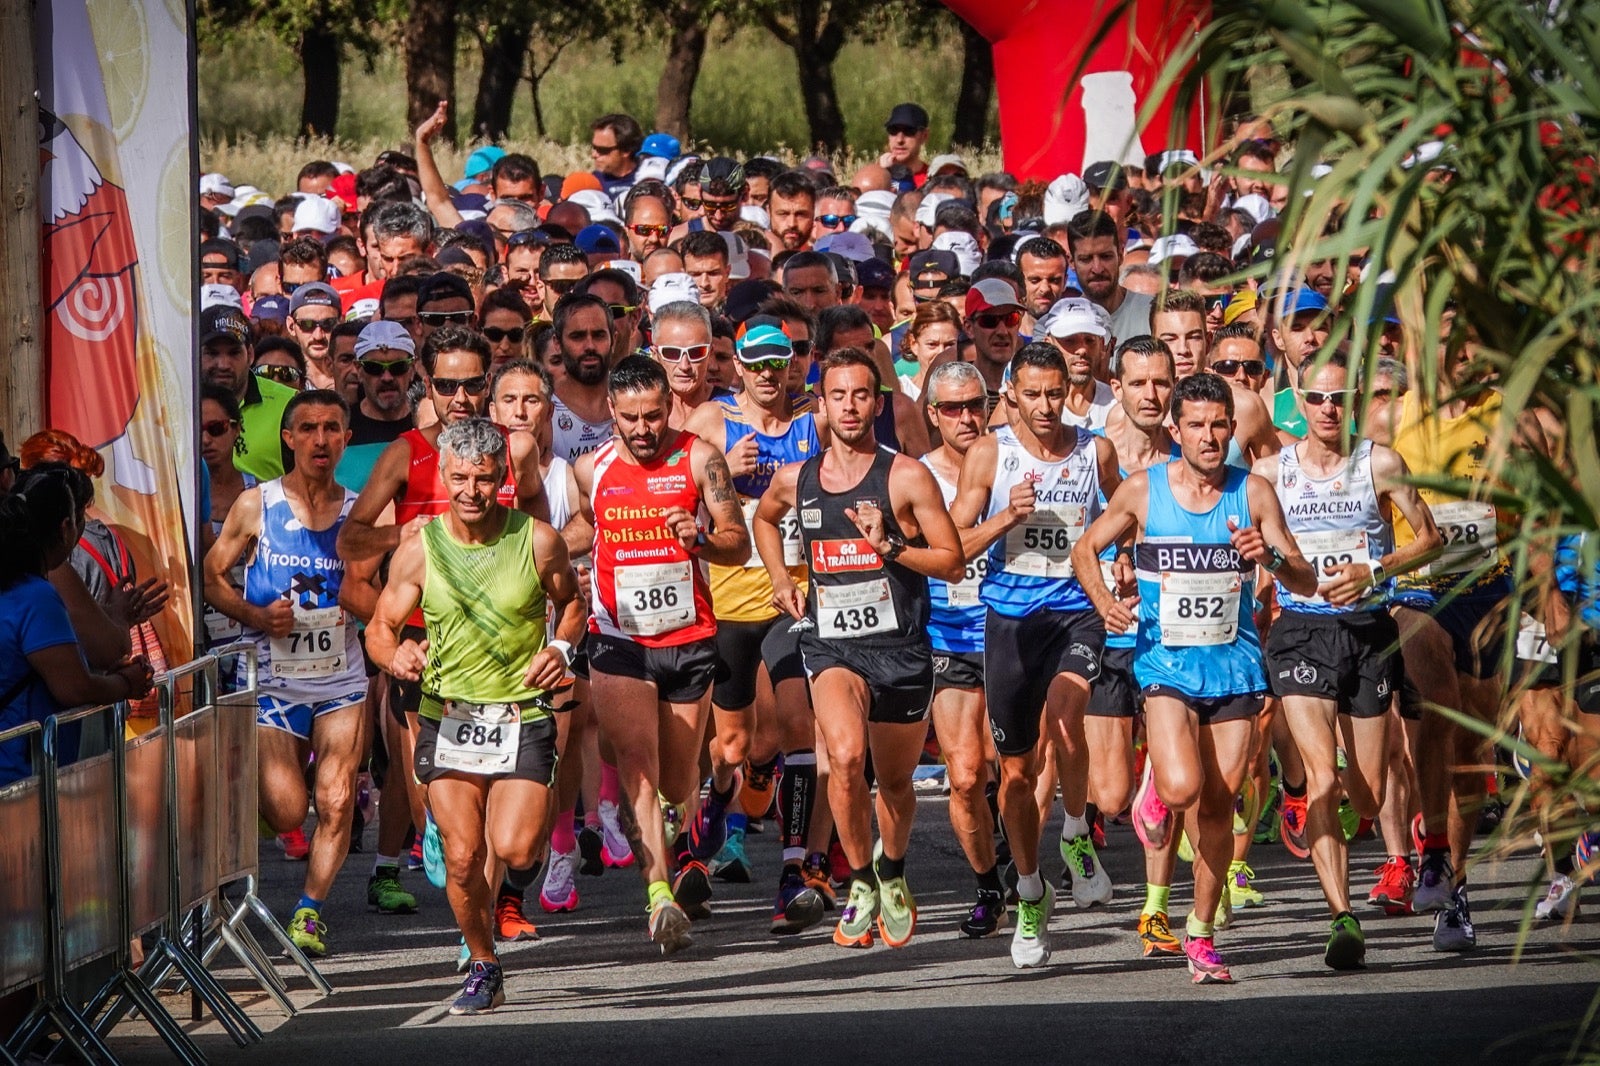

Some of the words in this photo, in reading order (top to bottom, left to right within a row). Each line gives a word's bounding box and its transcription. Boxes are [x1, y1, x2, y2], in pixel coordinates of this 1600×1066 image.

[604, 505, 667, 521] Clínica
[1288, 501, 1362, 516] MARACENA
[1024, 528, 1068, 550] 556
[272, 554, 311, 567] TODO
[616, 547, 668, 561] Continental
[827, 553, 877, 567] TRAINING
[634, 586, 678, 611] 386
[1178, 597, 1224, 618] 852
[834, 606, 879, 632] 438
[287, 631, 331, 654] 716
[456, 724, 502, 747] 684
